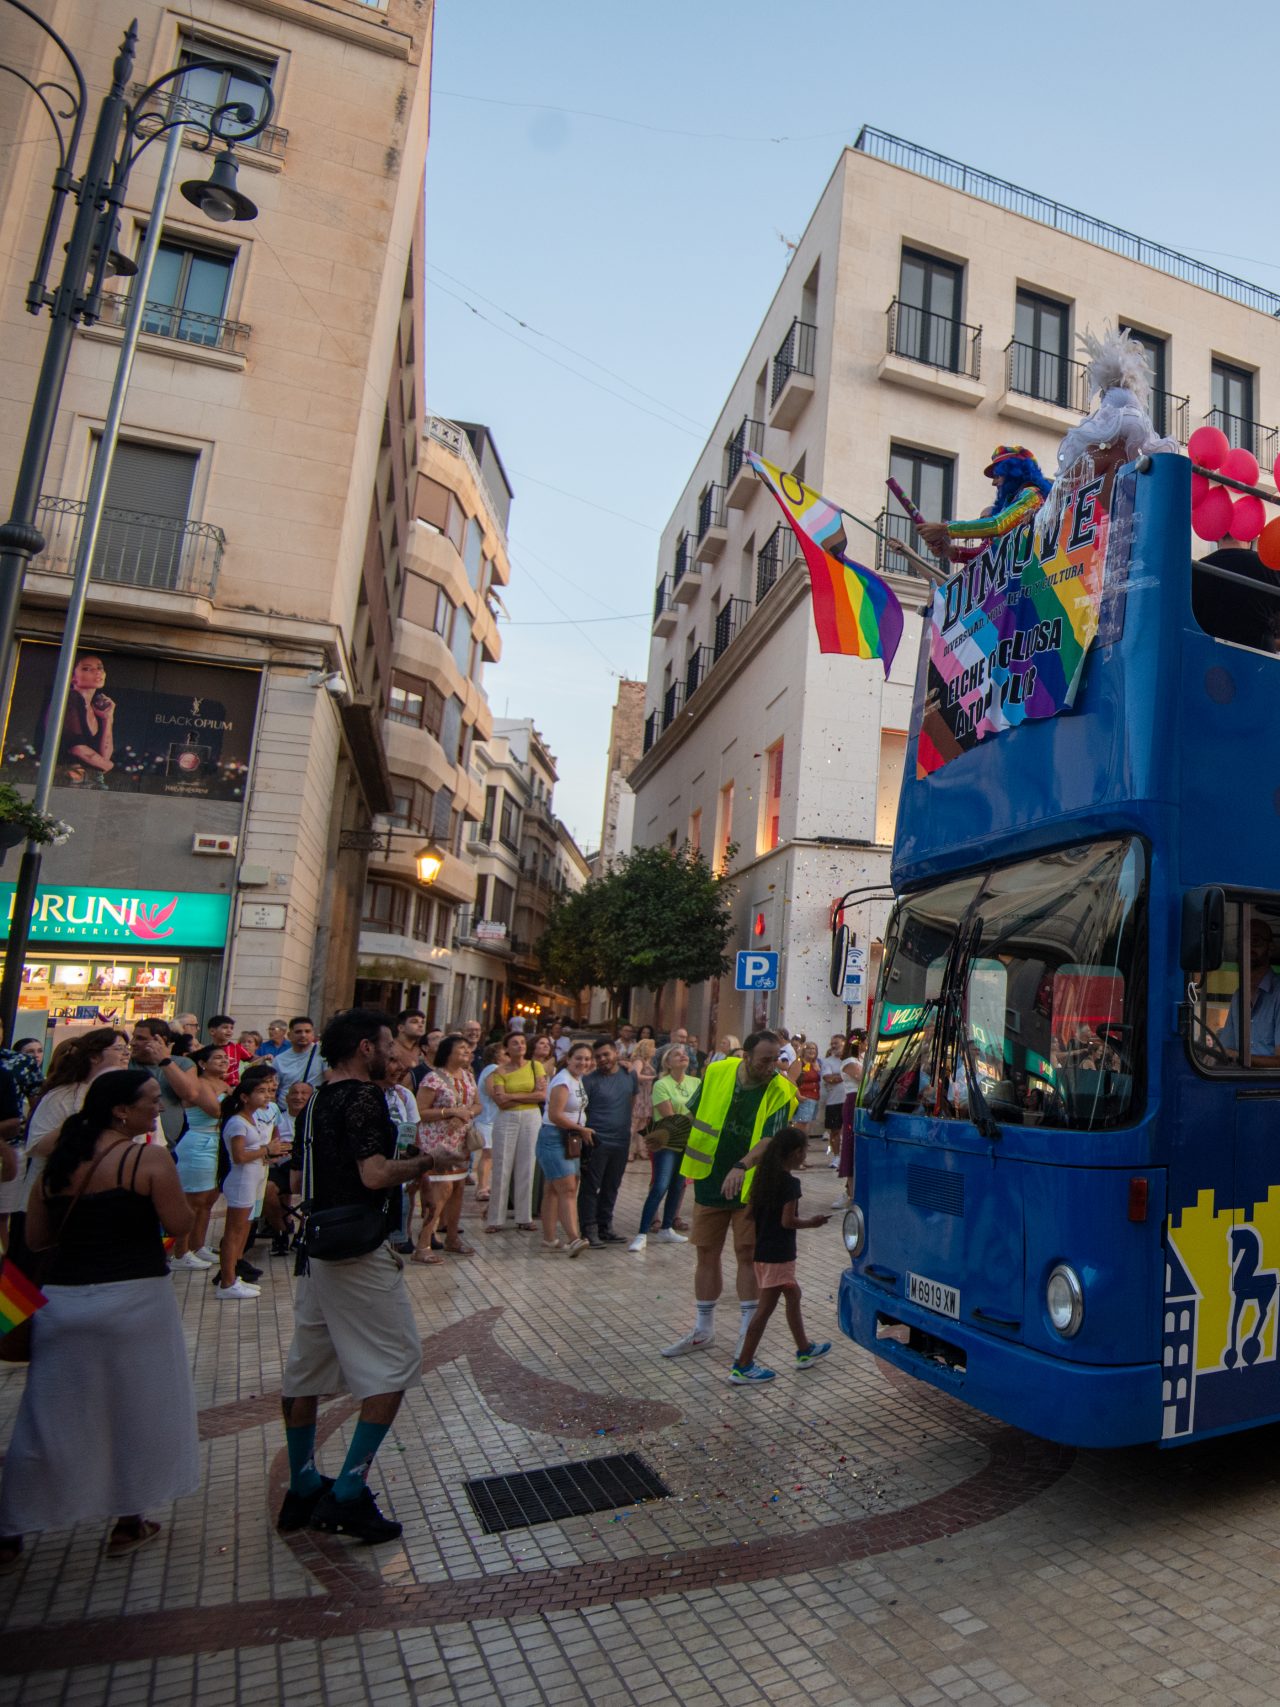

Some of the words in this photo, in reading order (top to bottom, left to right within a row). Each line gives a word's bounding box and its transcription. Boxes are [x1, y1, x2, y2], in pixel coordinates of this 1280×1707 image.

[1041, 563, 1085, 591] CULTURA
[947, 657, 986, 709] ELCHE
[155, 714, 193, 727] BLACK
[194, 718, 233, 731] OPIUM
[8, 924, 131, 937] RFUMERIES
[745, 956, 770, 986] P
[911, 1276, 917, 1299] M
[918, 1280, 942, 1308] 6919
